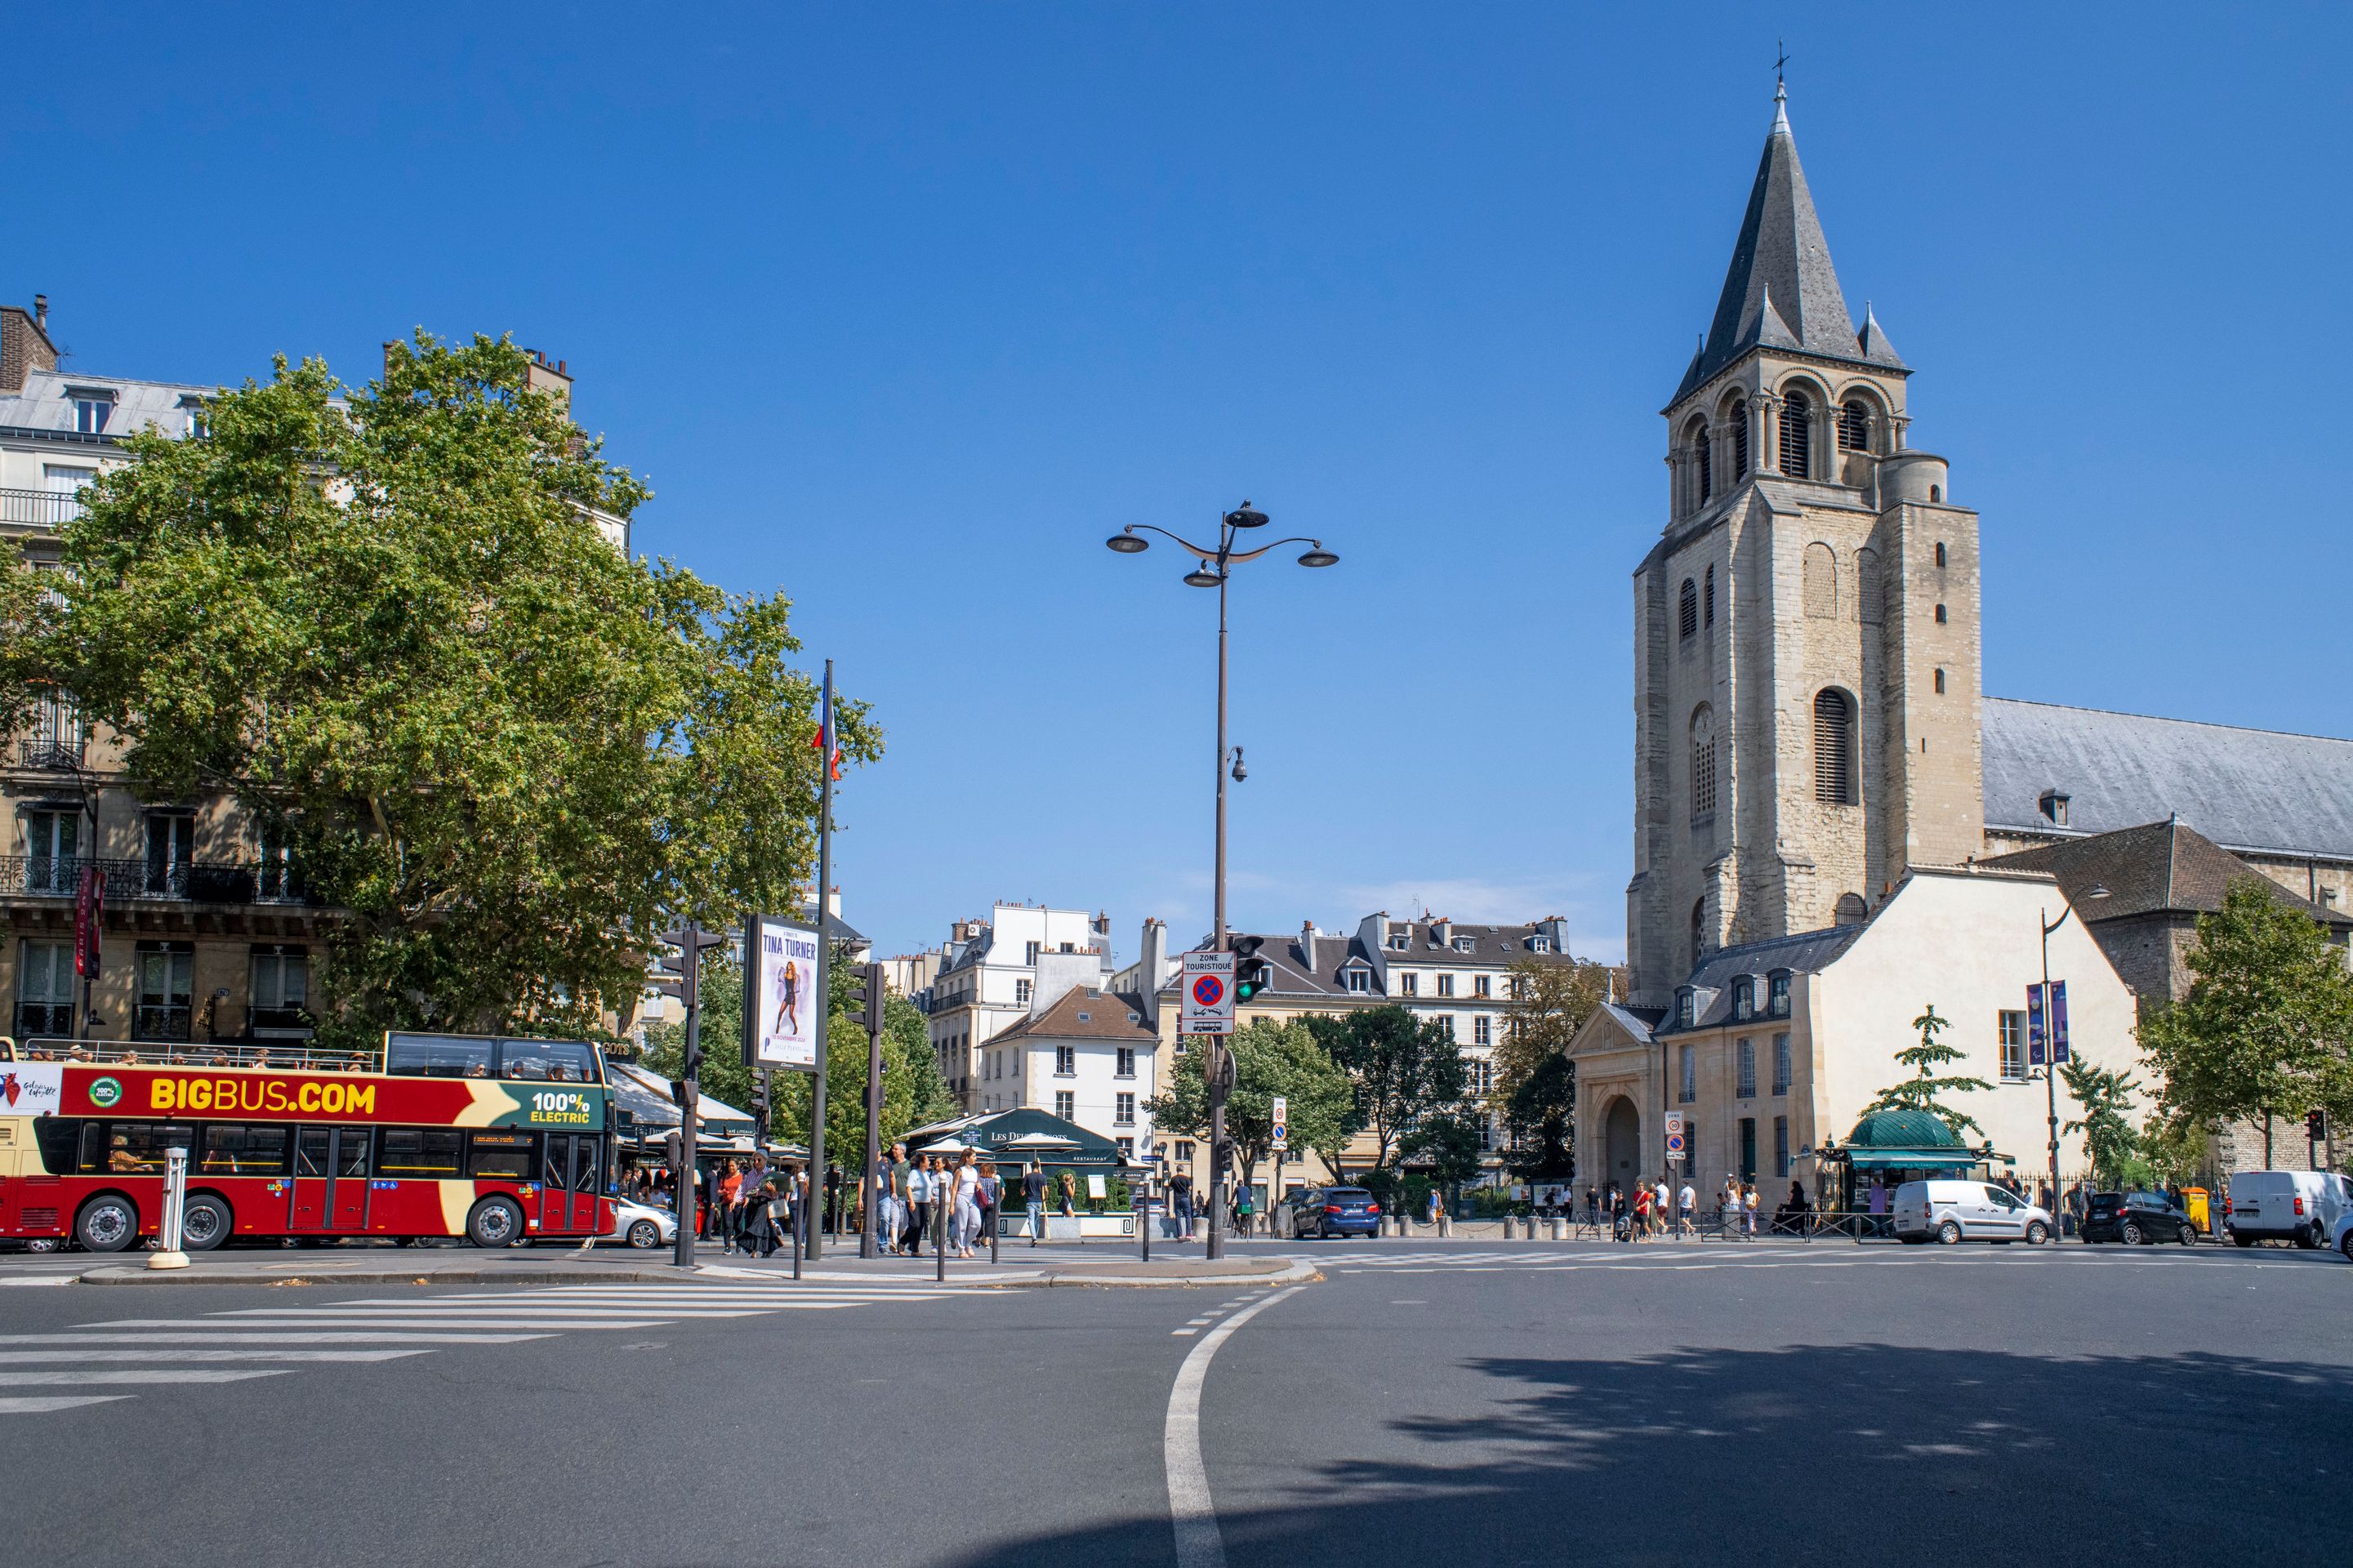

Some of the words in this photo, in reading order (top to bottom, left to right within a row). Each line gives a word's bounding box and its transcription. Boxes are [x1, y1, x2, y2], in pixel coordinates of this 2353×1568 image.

[763, 934, 782, 955] TINA
[786, 938, 816, 960] TURNER
[1199, 954, 1219, 962] ZONE
[150, 1079, 376, 1114] BIGBUS.COM
[532, 1092, 590, 1113] 100%
[530, 1111, 590, 1123] ELECTRIC
[992, 1132, 1007, 1141] LES
[1009, 1132, 1030, 1141] DEU
